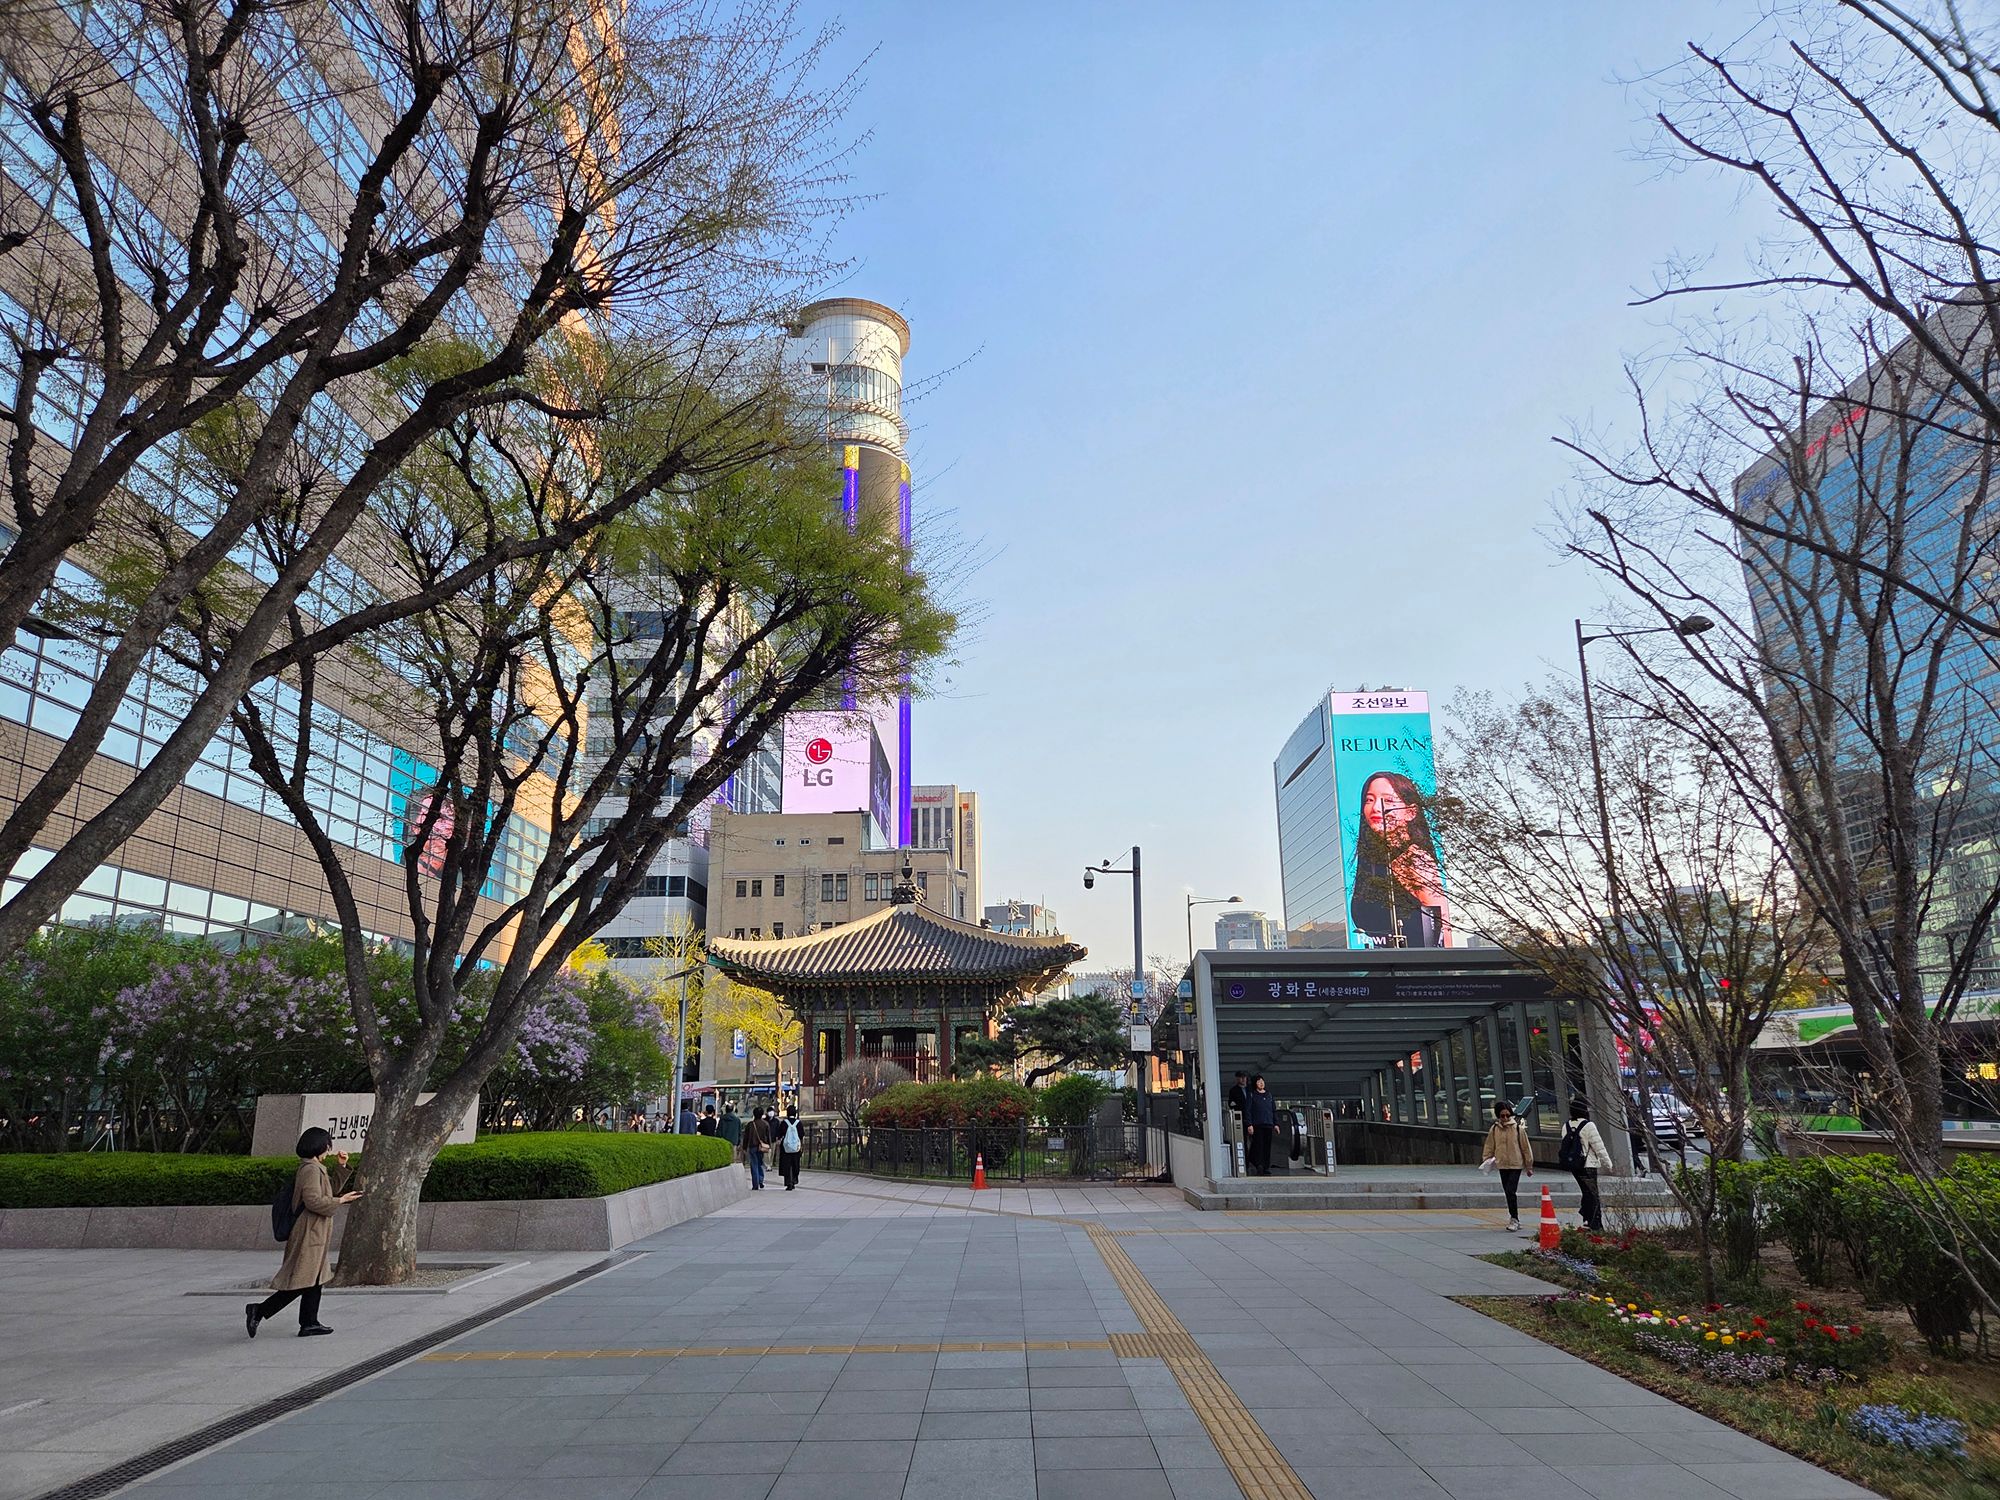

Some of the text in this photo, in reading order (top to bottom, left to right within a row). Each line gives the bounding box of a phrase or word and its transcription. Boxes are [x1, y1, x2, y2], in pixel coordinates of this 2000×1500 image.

[1352, 697, 1409, 709] 조선일보
[1341, 738, 1428, 752] REJURAN
[803, 768, 833, 787] LG
[1268, 982, 1370, 998] 광화문 (세종문화회관)
[328, 1115, 369, 1140] 교보생명
